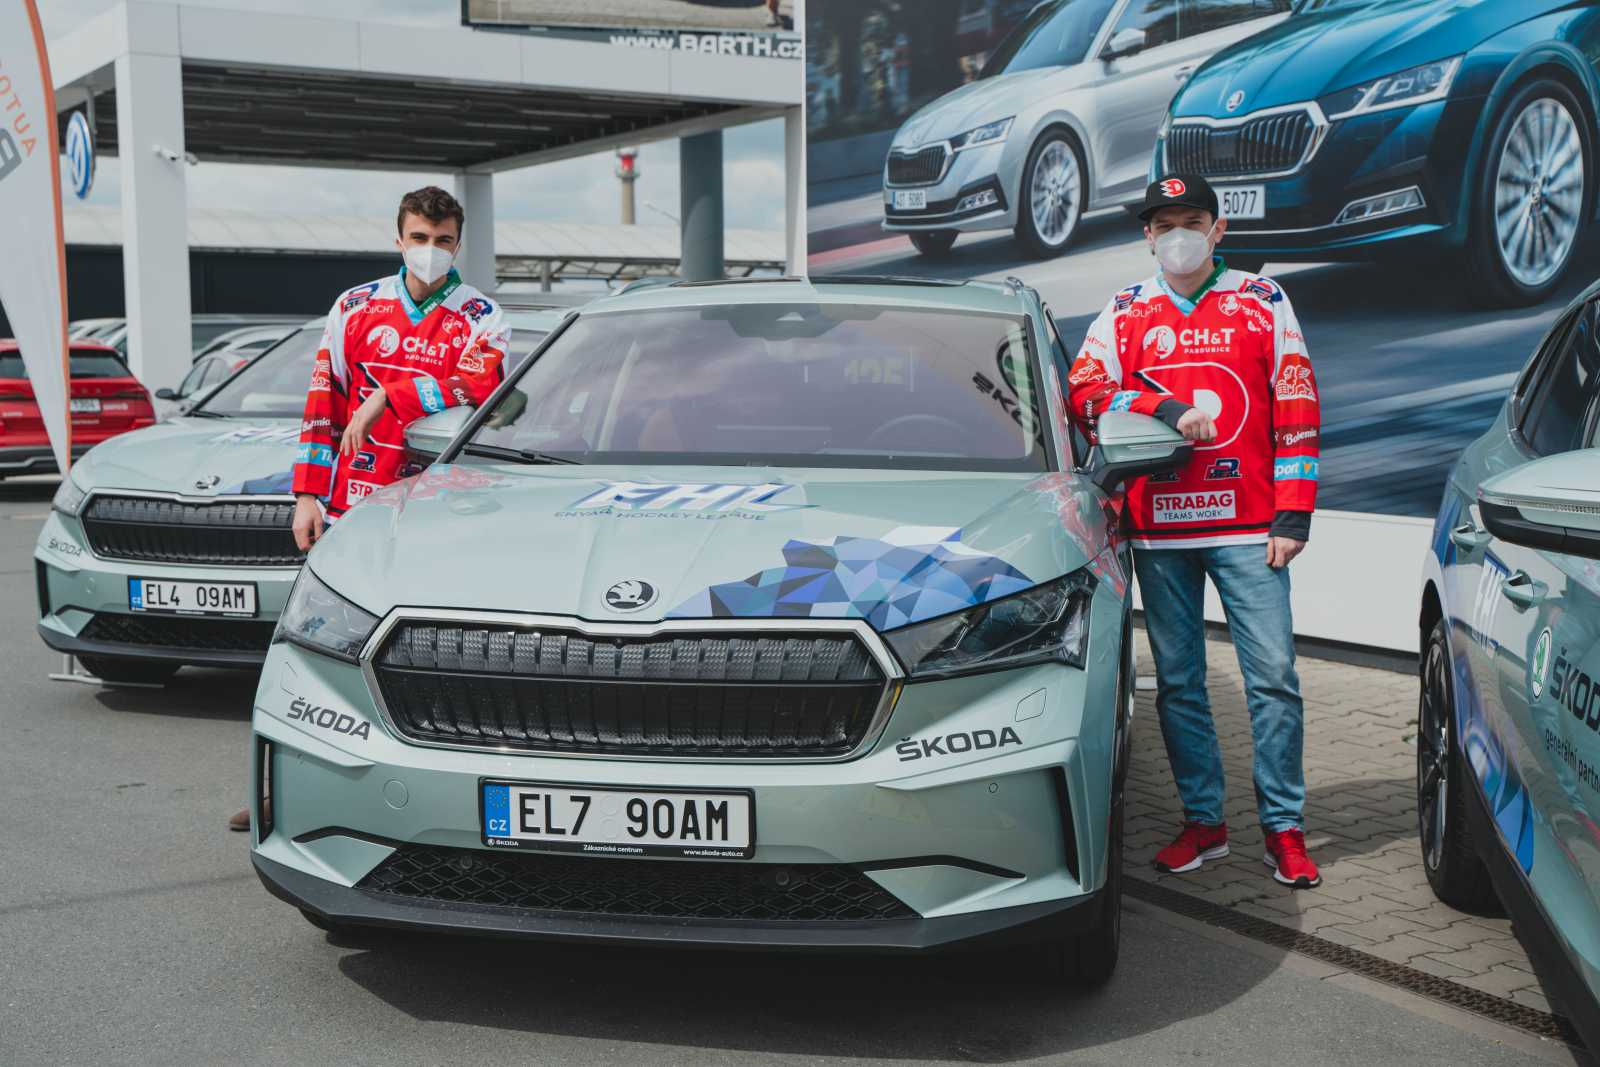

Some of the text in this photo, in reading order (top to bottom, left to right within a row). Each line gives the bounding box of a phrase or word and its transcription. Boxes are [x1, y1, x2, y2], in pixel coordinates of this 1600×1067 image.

[1223, 190, 1257, 215] 5077
[402, 336, 449, 358] CH&T
[1179, 328, 1236, 346] CH&T
[1155, 493, 1233, 511] STRABAG
[616, 511, 693, 520] HOCKEY
[1163, 509, 1223, 521] TEAMS WORK
[146, 583, 246, 610] EL4 09AM
[1549, 646, 1600, 736] ŠKOD
[286, 696, 371, 741] ŠKODA
[895, 735, 1023, 762] ŠKODA
[1578, 758, 1600, 793] partn
[489, 792, 729, 842] CZ EL7 90AM
[617, 847, 643, 855] centrum
